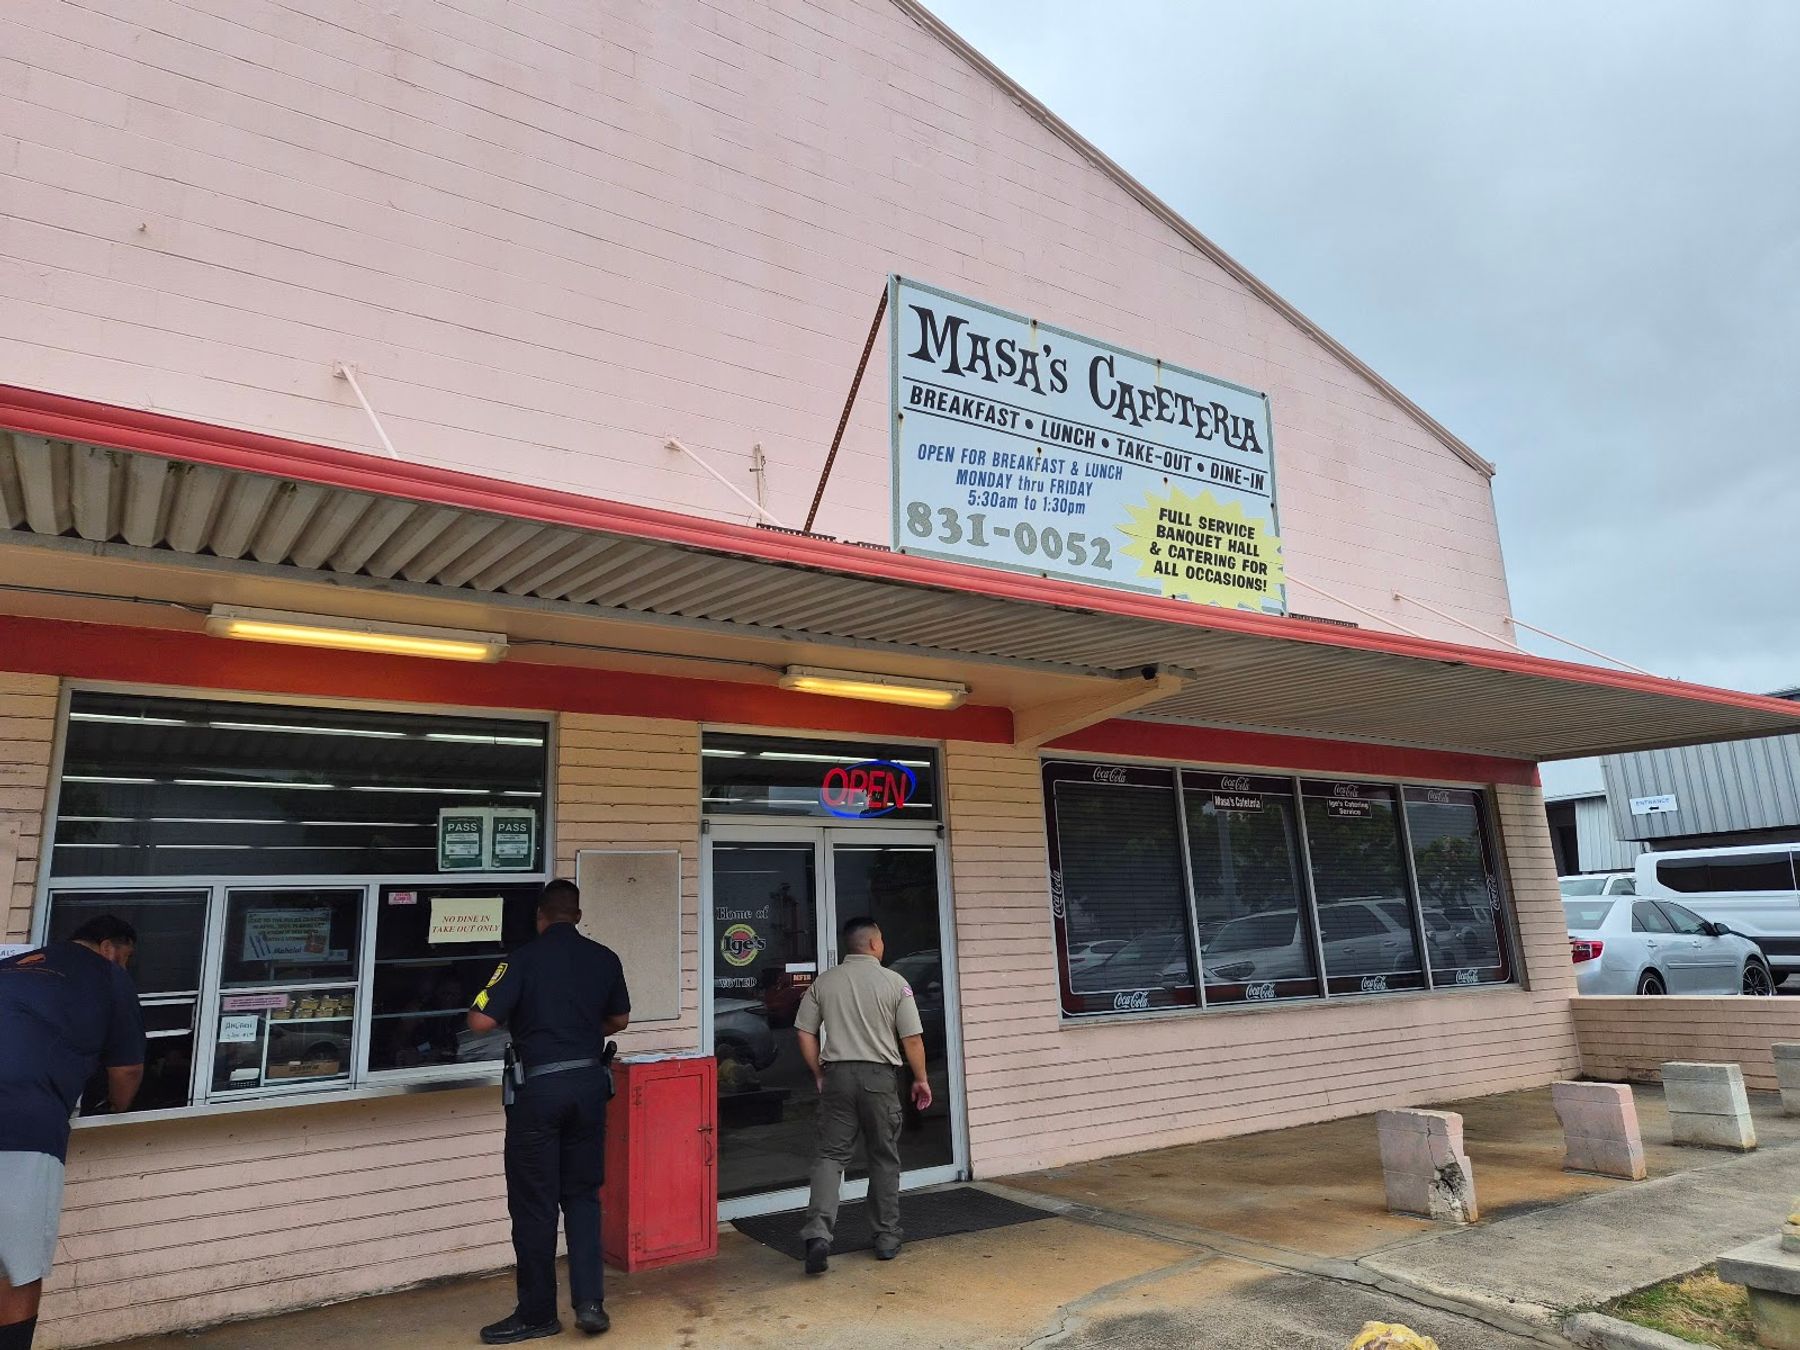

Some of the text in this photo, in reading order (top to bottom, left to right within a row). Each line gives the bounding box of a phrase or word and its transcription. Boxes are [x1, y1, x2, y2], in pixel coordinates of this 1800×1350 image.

[909, 385, 1265, 491] BREAKFAST LUNCH TAKE-OUT DINE-IN
[917, 443, 1123, 481] OPEN FOR BREAKFAST & LUNCH
[956, 469, 1094, 497] MONDAY thru FRIDAY
[967, 489, 1086, 516] 5:30am to 1:30pm
[906, 501, 1113, 571] 831-0052
[1159, 507, 1255, 540] FULL SERVICE
[1156, 524, 1260, 557] BANQUET HALL
[1149, 541, 1268, 576] & CATERING FOR
[1153, 560, 1267, 592] ALL OCCASIONS!
[822, 767, 907, 809] OPEN
[447, 823, 478, 832] PASS
[498, 823, 527, 832] PASS
[442, 915, 491, 924] NO DINE IN
[716, 904, 769, 920] Home of
[432, 924, 501, 934] TAKE OUT ONLY
[722, 934, 767, 955] Ige's
